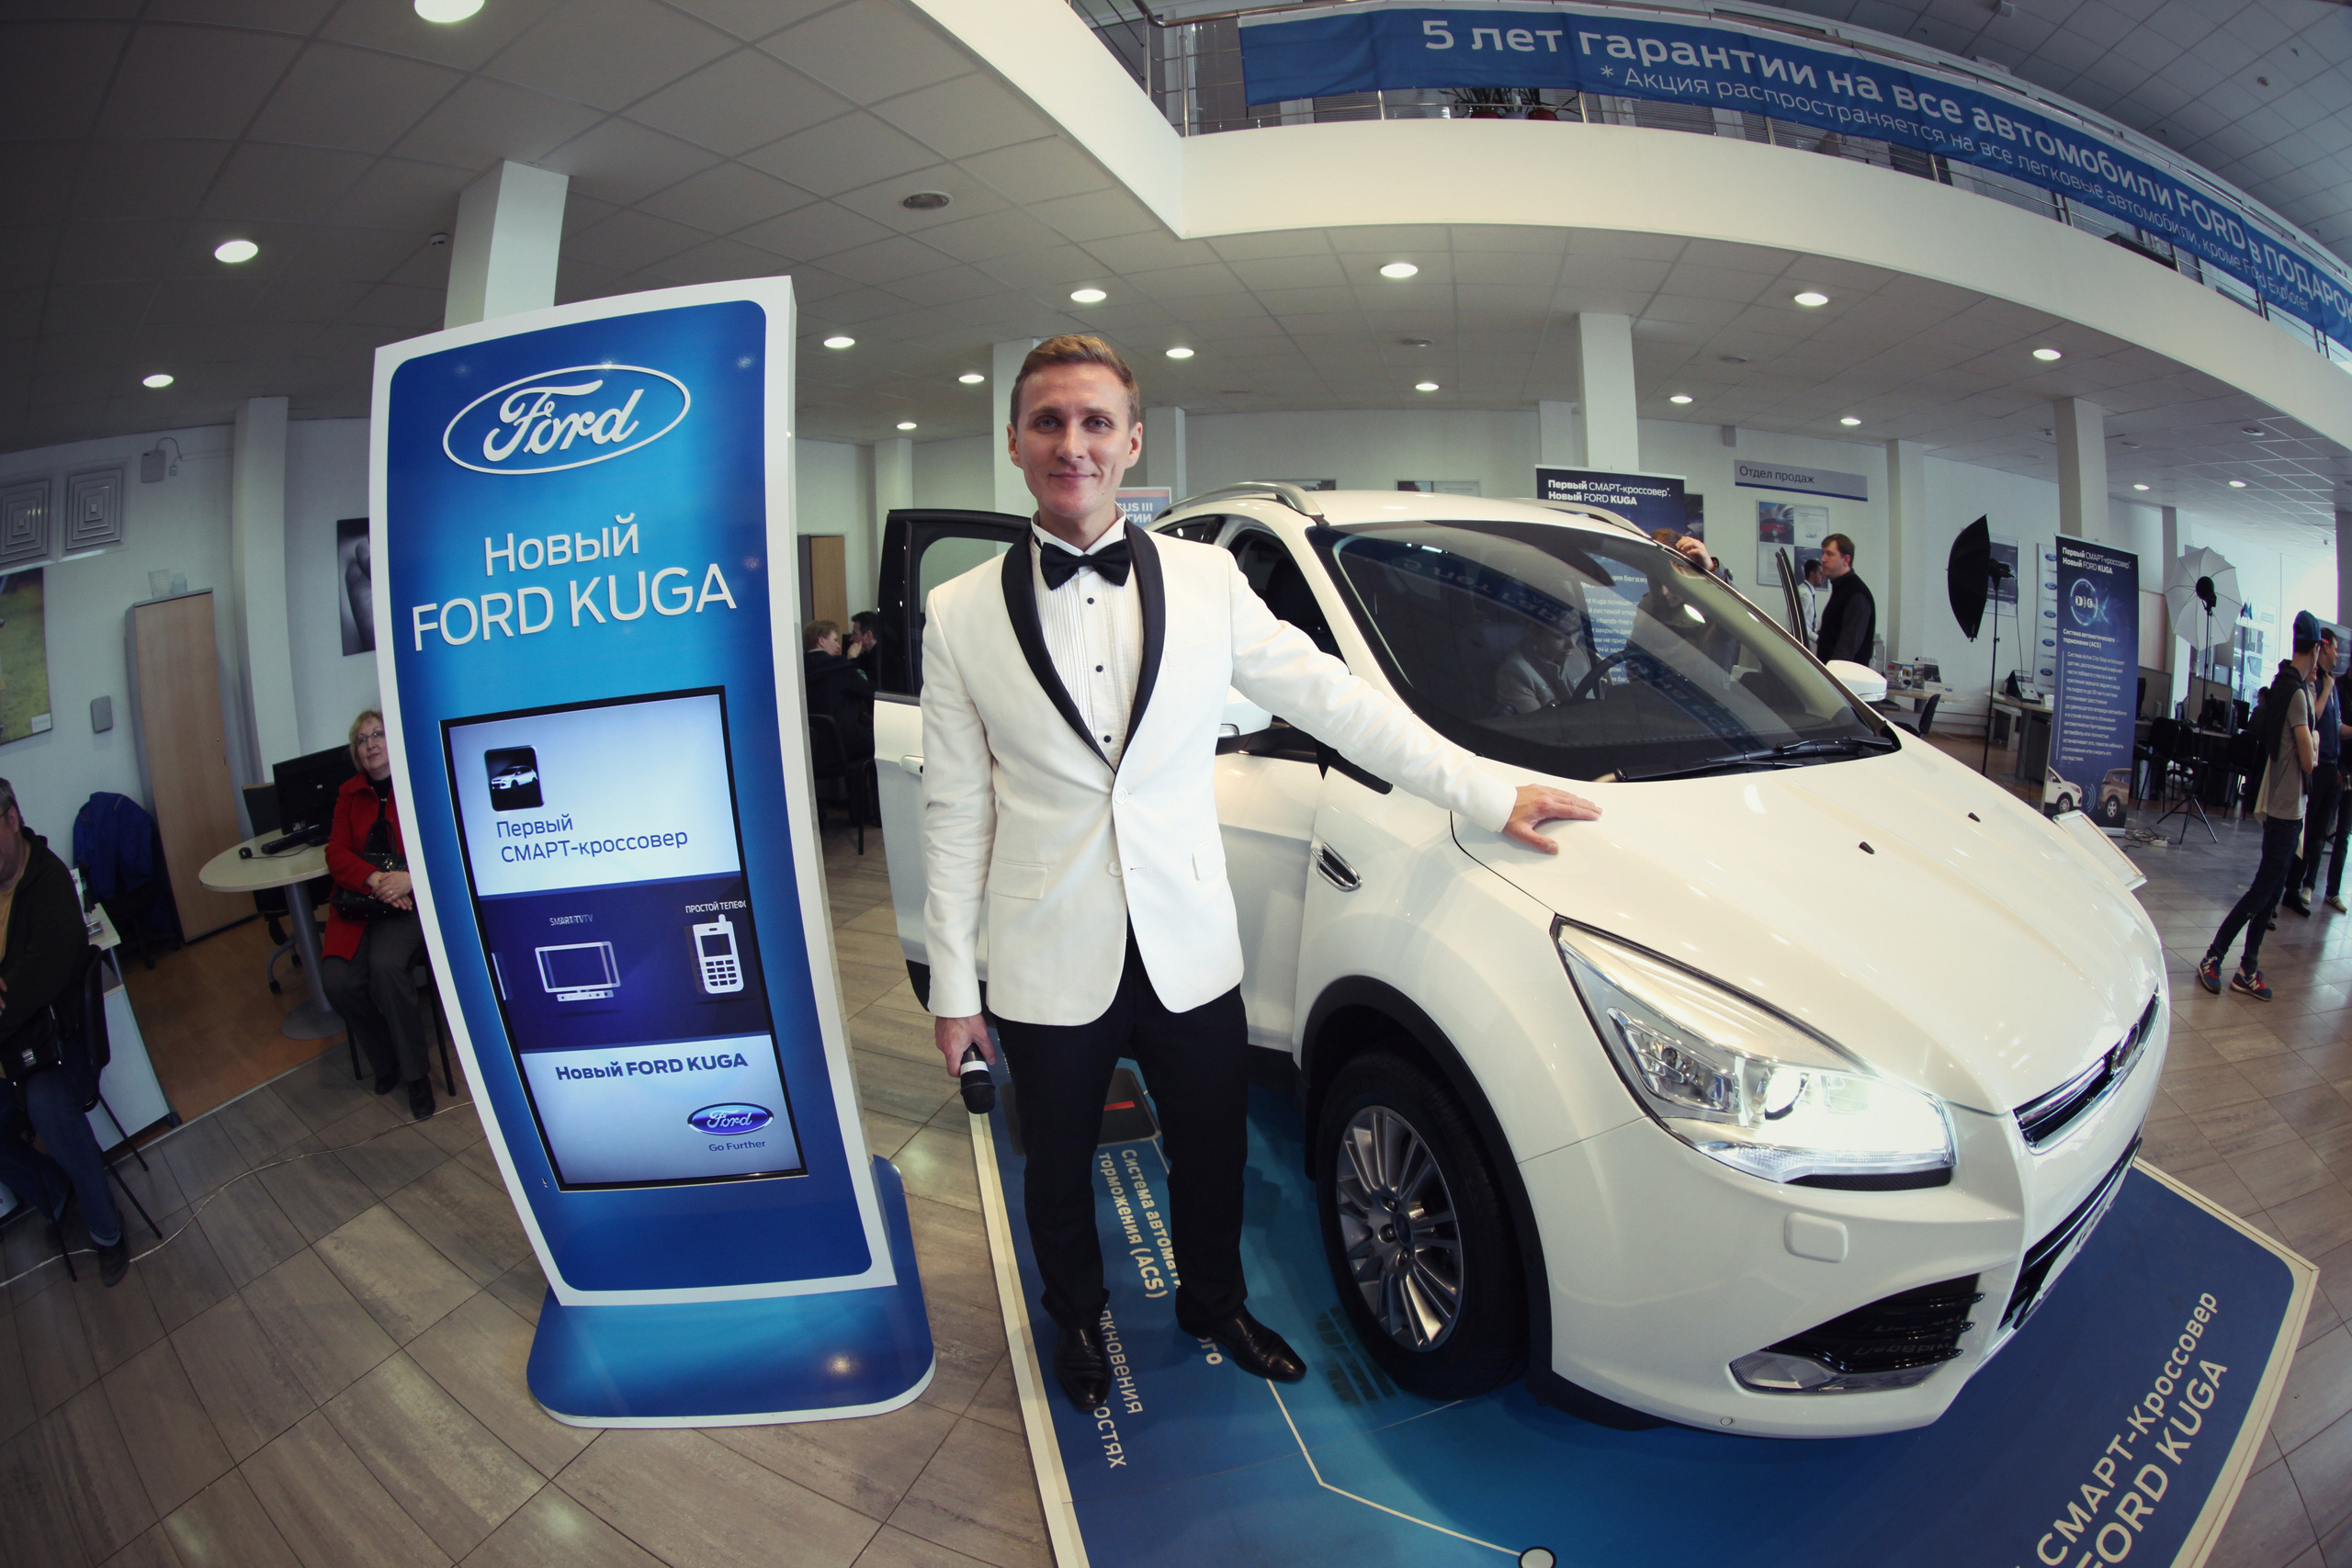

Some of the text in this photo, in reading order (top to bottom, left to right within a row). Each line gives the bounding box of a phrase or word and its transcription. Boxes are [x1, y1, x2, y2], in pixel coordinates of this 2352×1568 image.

[1422, 20, 1454, 50] 5
[1471, 28, 1564, 52] лет
[1578, 31, 1817, 89] гарантии
[1826, 70, 1883, 103] на
[1891, 85, 1964, 124] все
[1971, 107, 2174, 211] автомобили
[2175, 188, 2245, 250] FORD
[1624, 67, 1710, 96] Акция
[1715, 82, 1946, 144] распространяется
[1950, 133, 1976, 152] на
[1979, 141, 2014, 164] все
[2018, 154, 2104, 199] легковые
[2107, 190, 2201, 250] автомобили,
[2202, 235, 2242, 270] кроме
[483, 379, 645, 462] Ford
[1548, 479, 1588, 491] Первый
[1739, 466, 1815, 483] Отдел продаж
[1548, 491, 1638, 505] Новый FORD KUGA
[484, 512, 639, 577] Новый
[2097, 564, 2113, 574] KUGA
[412, 563, 738, 651] FORD KUGA
[496, 813, 573, 839] Первый
[501, 829, 689, 863] СМАРТ-кроссовер
[684, 901, 719, 913] ПРОСТОЙ
[556, 1052, 750, 1081] Новый FORD KUGA
[707, 1109, 752, 1128] Ford
[708, 1140, 766, 1152] Go Further
[1121, 1149, 1156, 1209] Система
[1098, 1152, 1169, 1298] торможения (ACS)
[2036, 1292, 2218, 1566] СМАРТ-Кроссовер
[2154, 1359, 2228, 1465] KUGA
